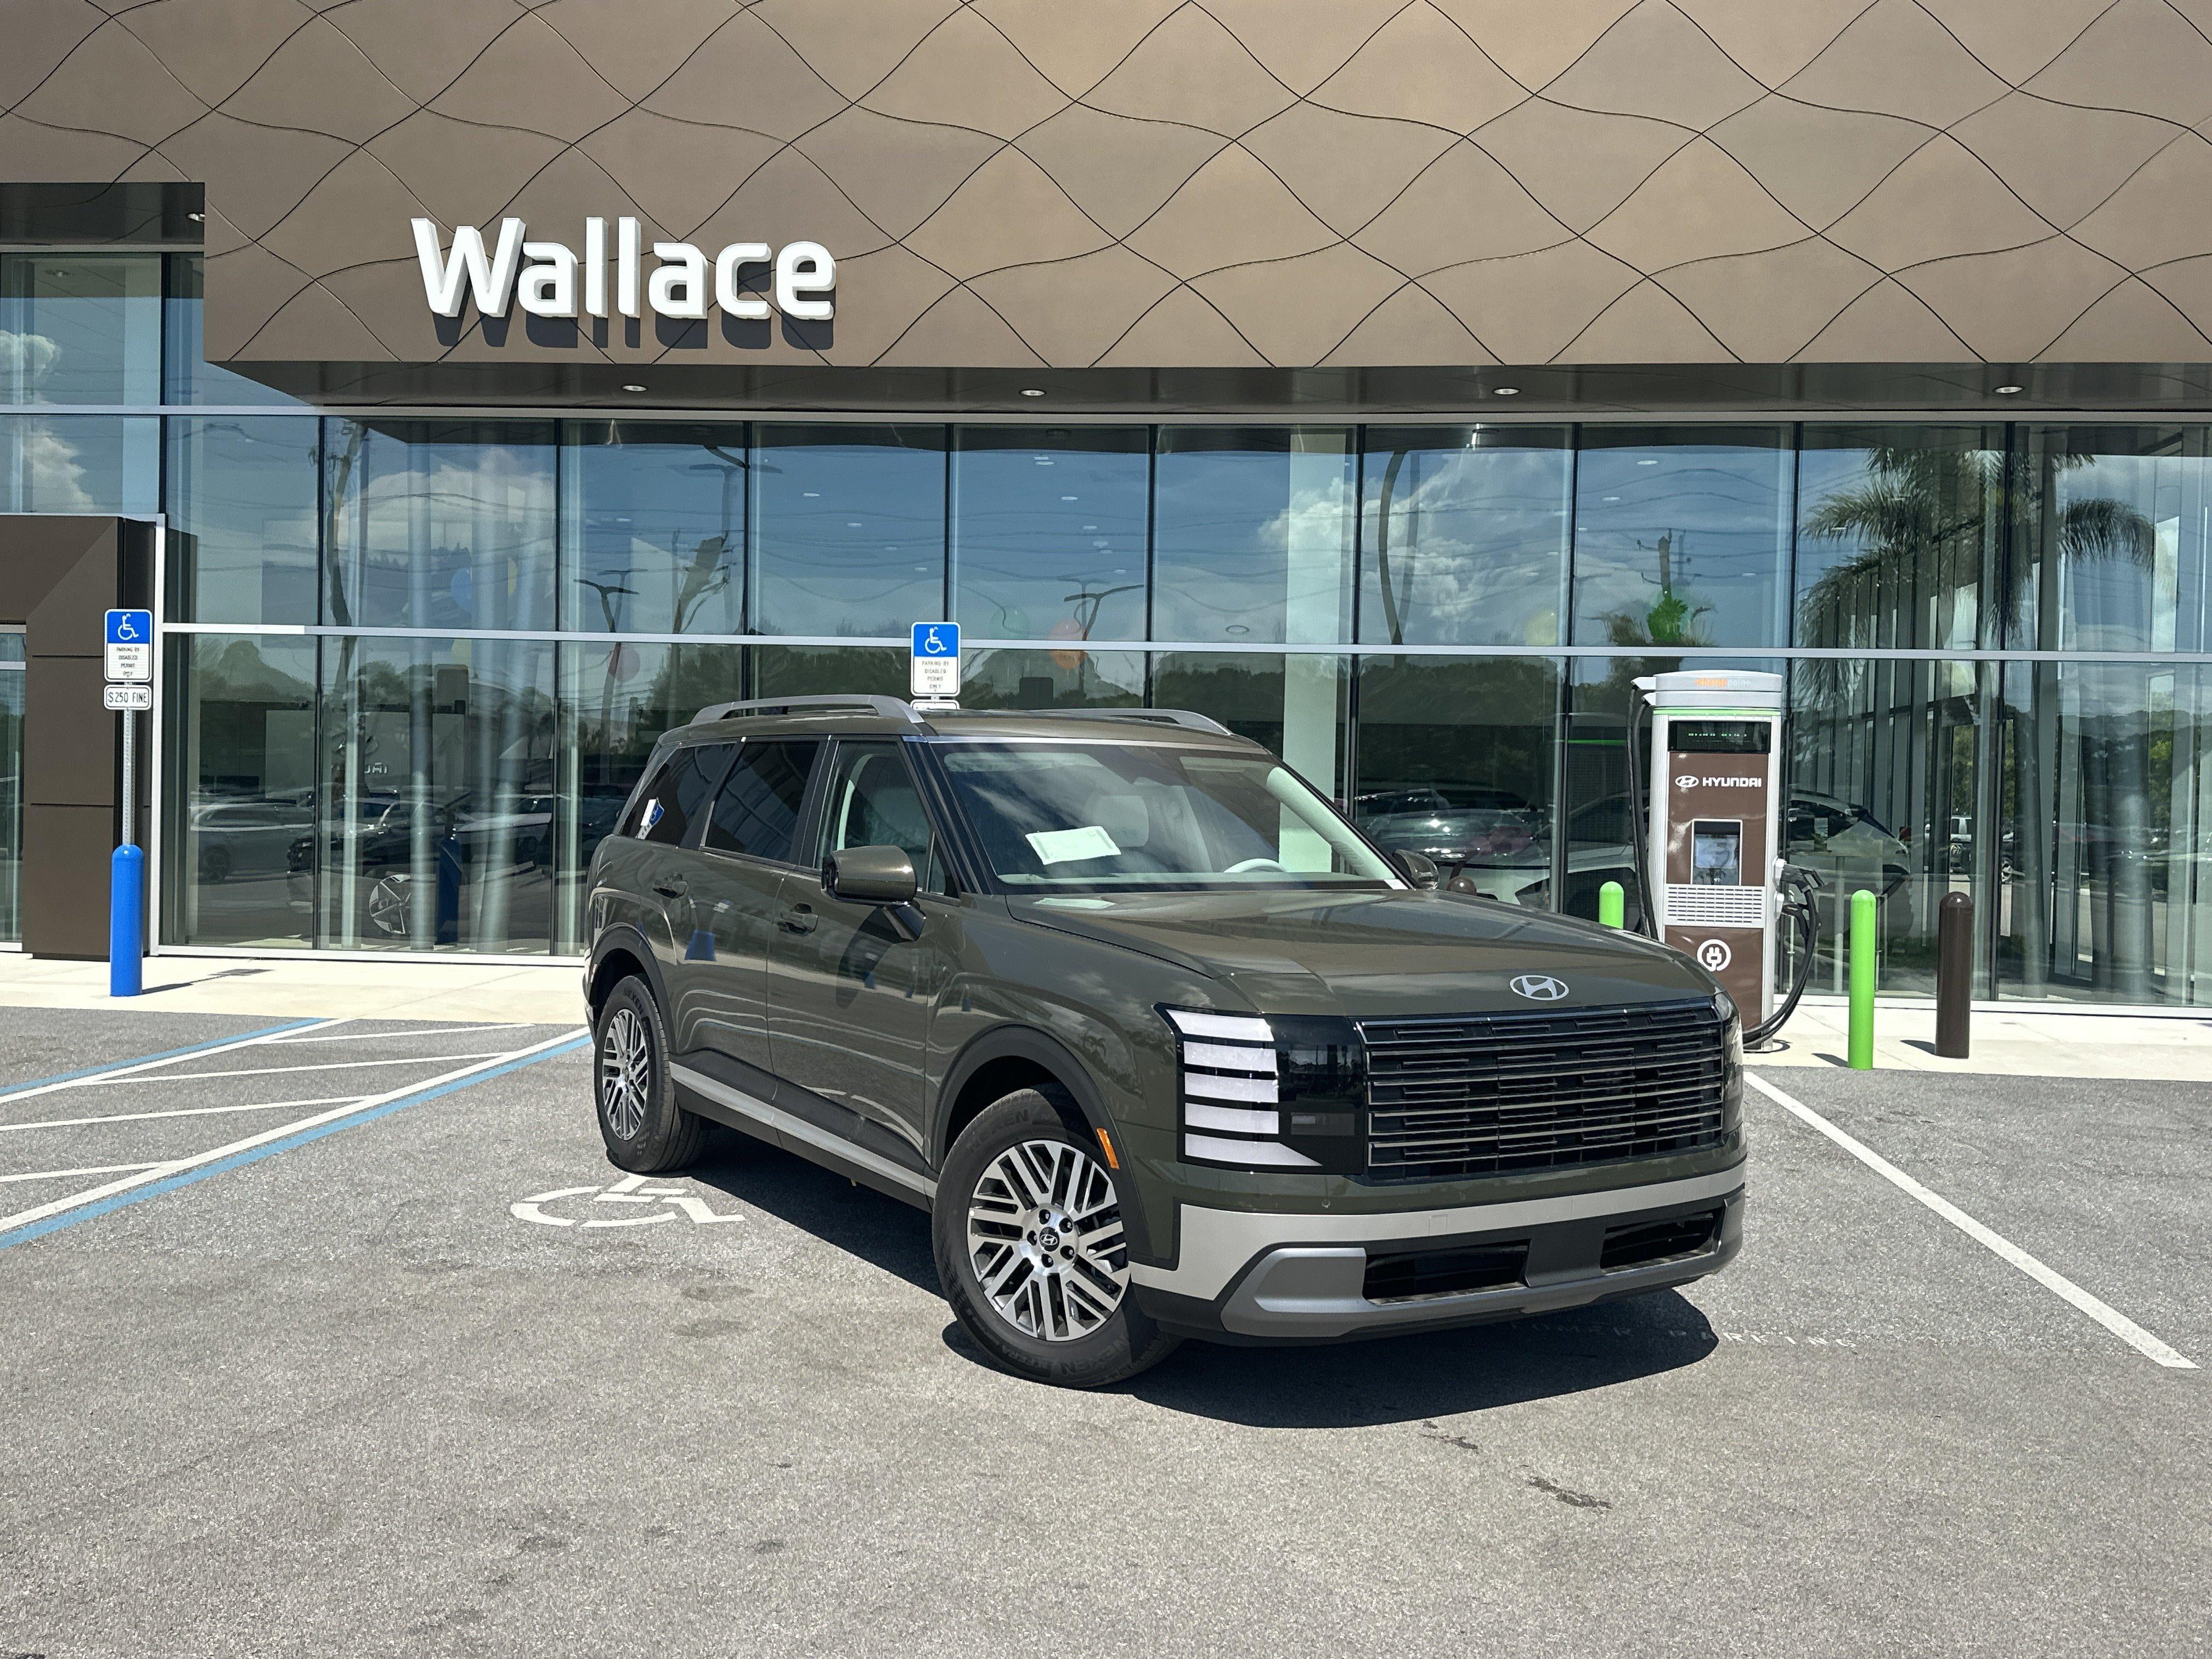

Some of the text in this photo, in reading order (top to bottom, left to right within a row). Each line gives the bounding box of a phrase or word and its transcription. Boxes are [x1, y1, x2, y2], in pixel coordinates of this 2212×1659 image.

[410, 217, 837, 320] Wallace
[108, 692, 147, 703] $250 FINE
[1702, 777, 1762, 787] HYUNDAI
